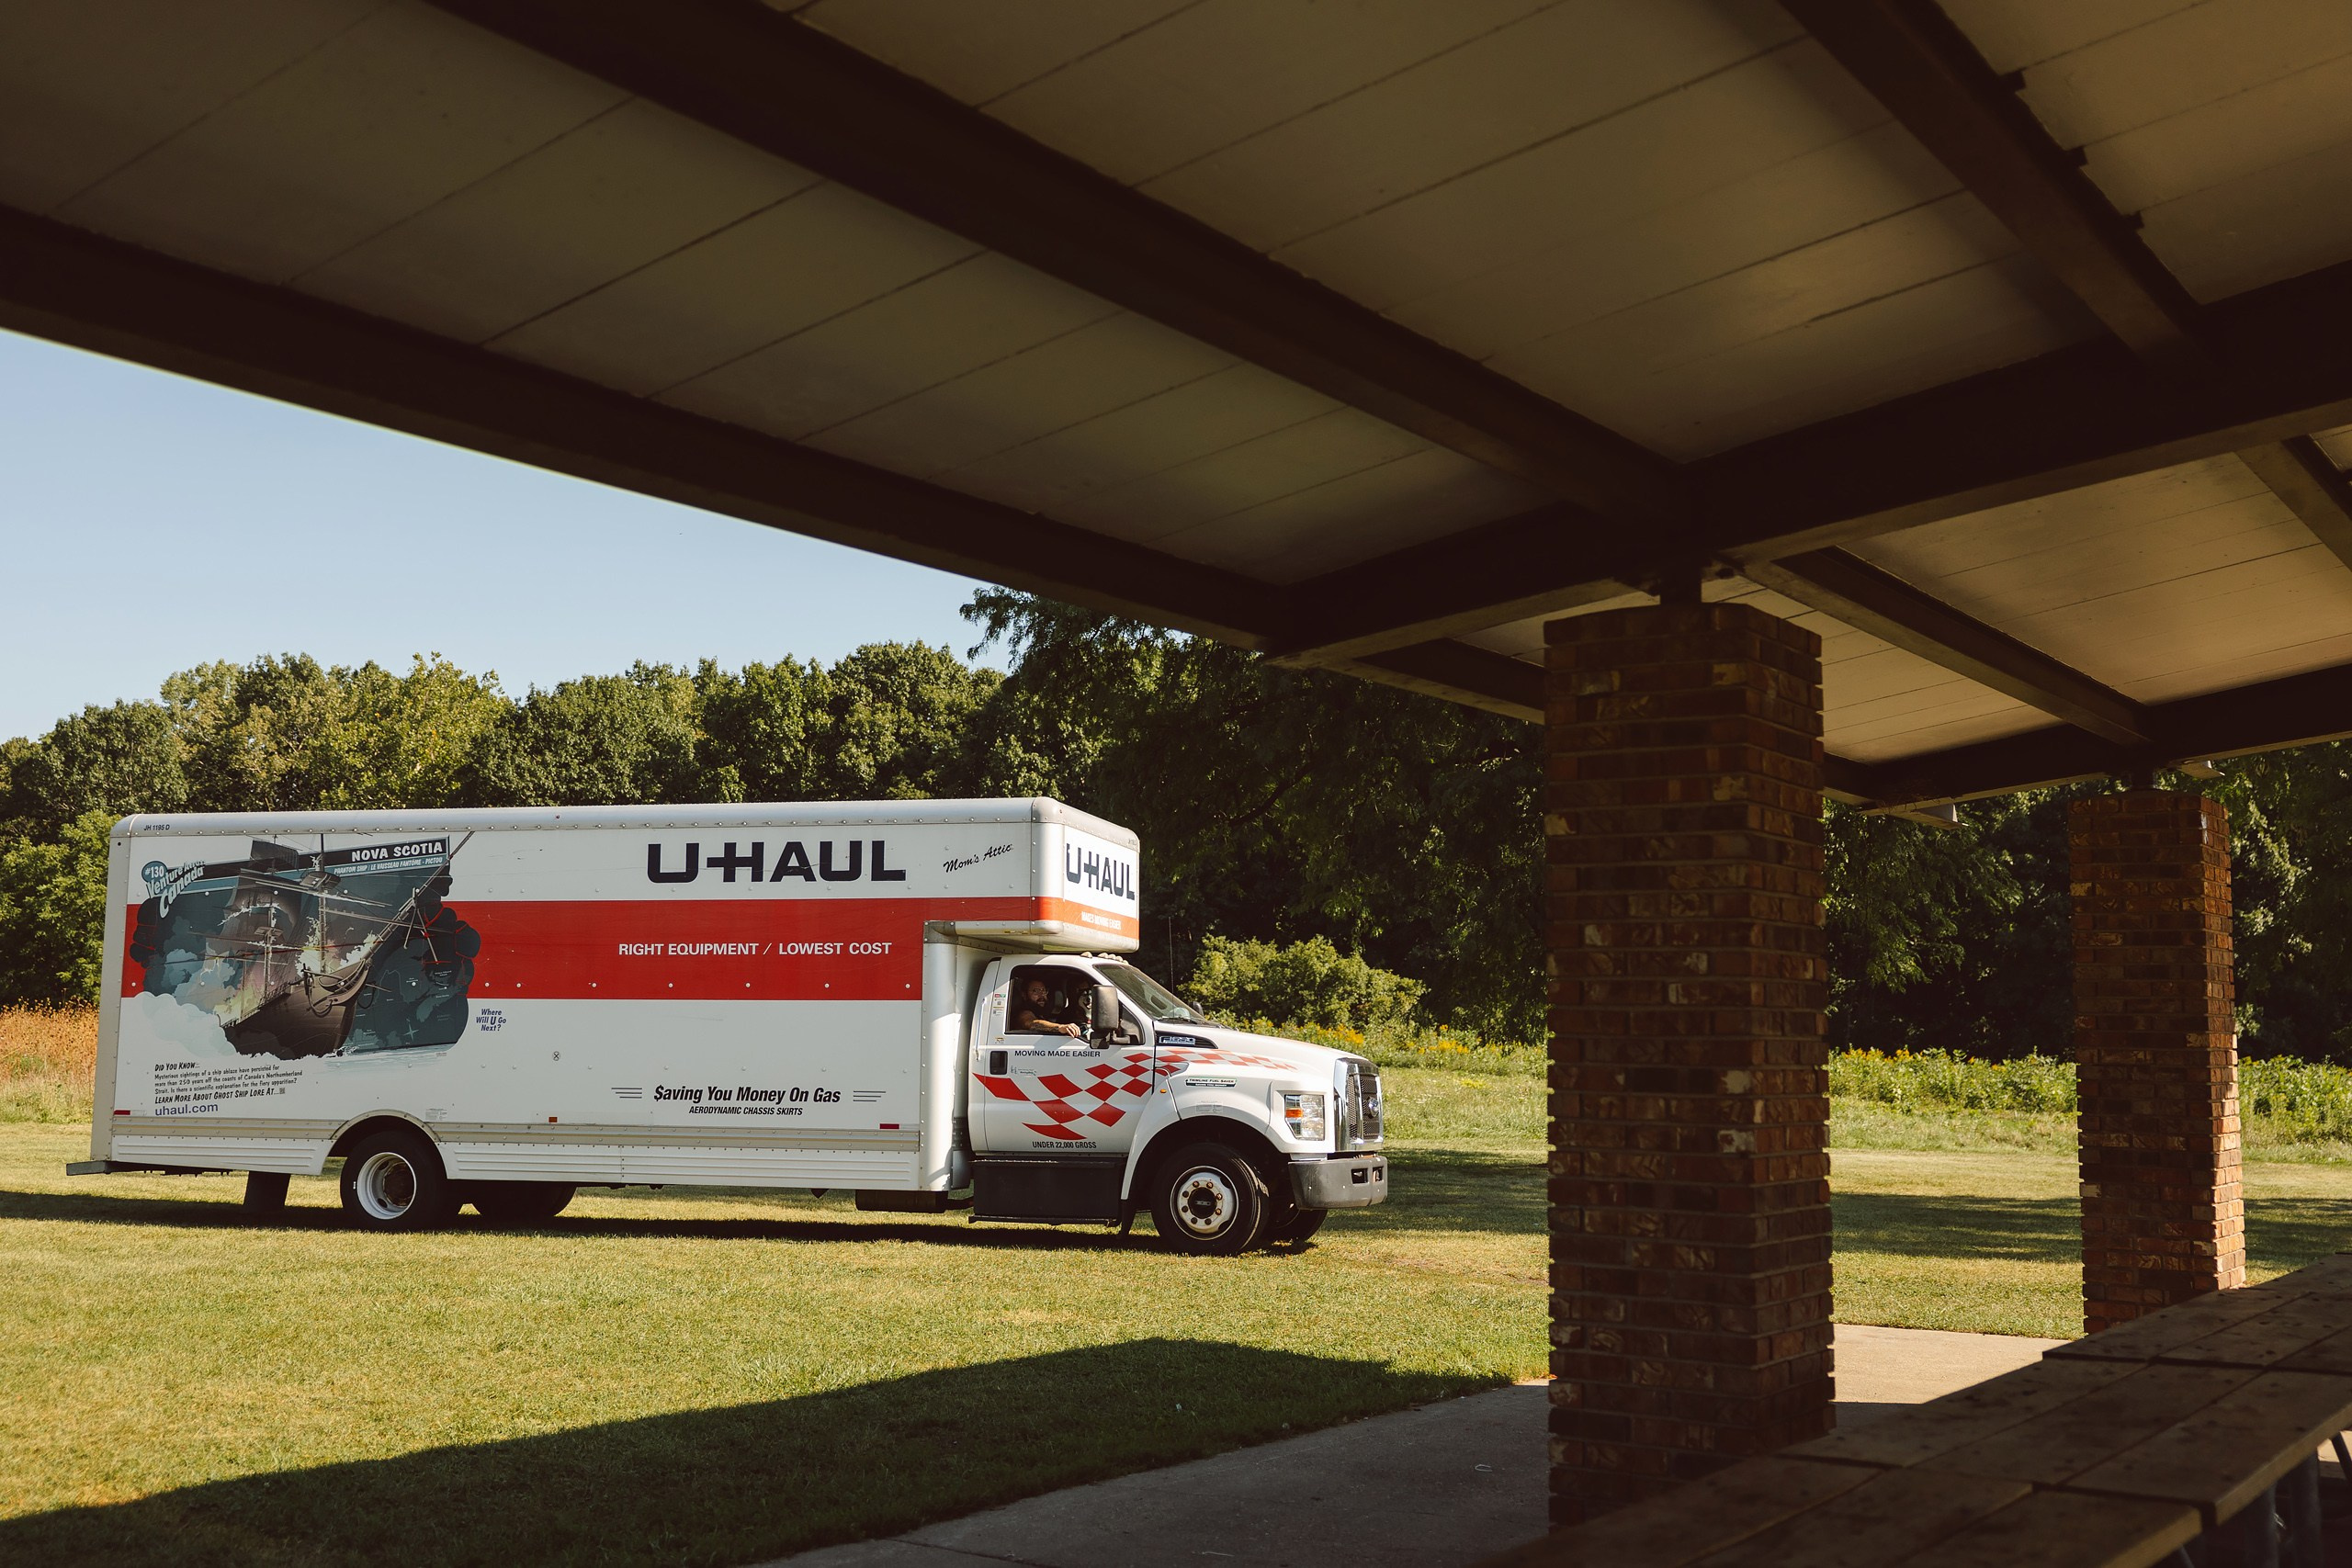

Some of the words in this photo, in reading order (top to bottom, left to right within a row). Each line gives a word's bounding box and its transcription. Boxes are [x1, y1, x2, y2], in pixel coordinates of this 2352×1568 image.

[352, 848, 389, 862] NOVA
[393, 842, 443, 857] SCOTIA
[944, 854, 979, 873] Mom's
[983, 844, 1012, 861] Attic
[145, 866, 164, 878] #130
[334, 865, 356, 874] PHANTOM
[378, 862, 400, 870] VAISSEAU
[146, 866, 184, 899] Venture
[160, 866, 204, 919] Canada
[618, 943, 664, 955] RIGHT
[668, 943, 759, 955] EQUIPMENT
[779, 942, 843, 955] LOWEST
[849, 942, 892, 954] COST
[491, 1016, 497, 1025] U
[266, 1070, 303, 1078] Northumberland
[272, 1077, 298, 1086] apparition?
[707, 1086, 733, 1101] You
[736, 1087, 786, 1105] Money
[790, 1088, 809, 1102] On
[813, 1088, 842, 1103] Gas
[155, 1104, 219, 1116] uhaul.com
[689, 1106, 742, 1115] AERODYNAMIC
[743, 1107, 775, 1115] CHASSIS
[776, 1107, 803, 1116] SKIRTS
